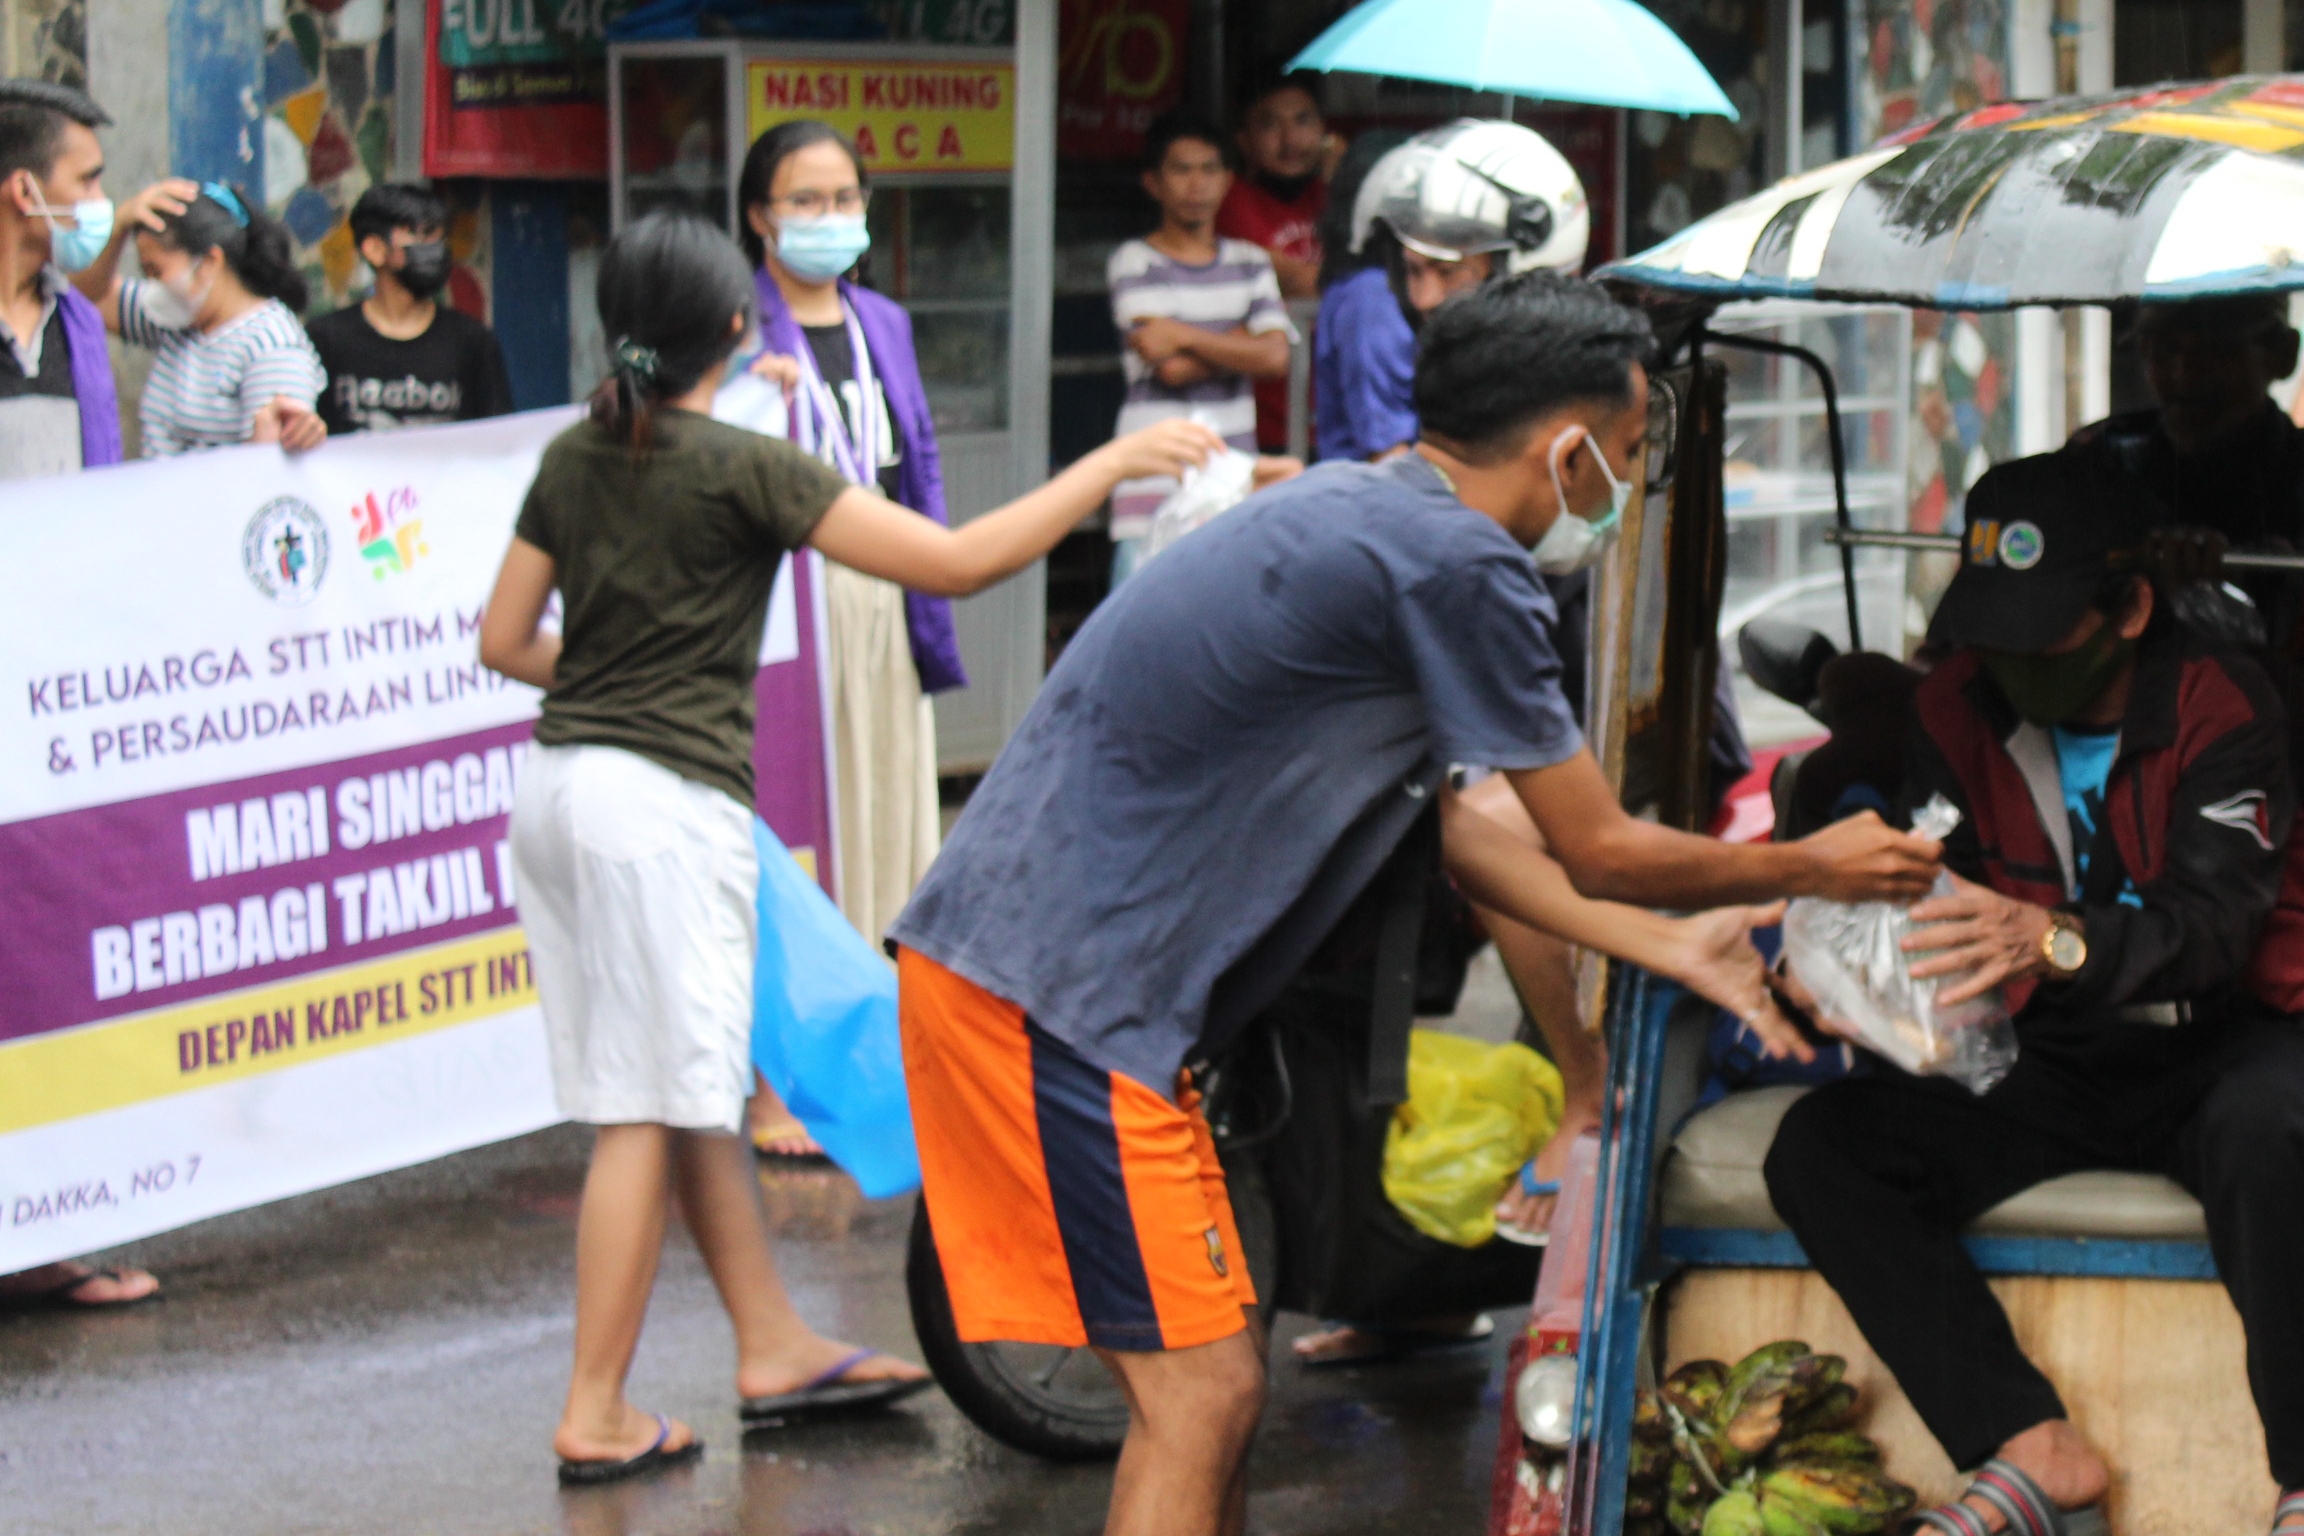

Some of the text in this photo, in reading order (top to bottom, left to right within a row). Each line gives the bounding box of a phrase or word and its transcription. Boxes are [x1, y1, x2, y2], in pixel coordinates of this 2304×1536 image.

[764, 73, 1000, 111] NASI KUNING
[855, 123, 962, 161] ACA
[28, 645, 251, 718] KELUARGA
[268, 632, 330, 677] STT
[342, 612, 444, 662] INTIM
[48, 736, 76, 775] &
[91, 673, 413, 769] PERSAUDARAAN
[185, 784, 330, 883] MARI
[91, 881, 329, 1002] BERBAGI
[332, 845, 494, 946] TAKJIL
[178, 950, 535, 1074] DEPAN KAPEL STT INT
[13, 1178, 119, 1228] DAKKA,
[131, 1160, 176, 1199] NO
[187, 1153, 202, 1187] 7
